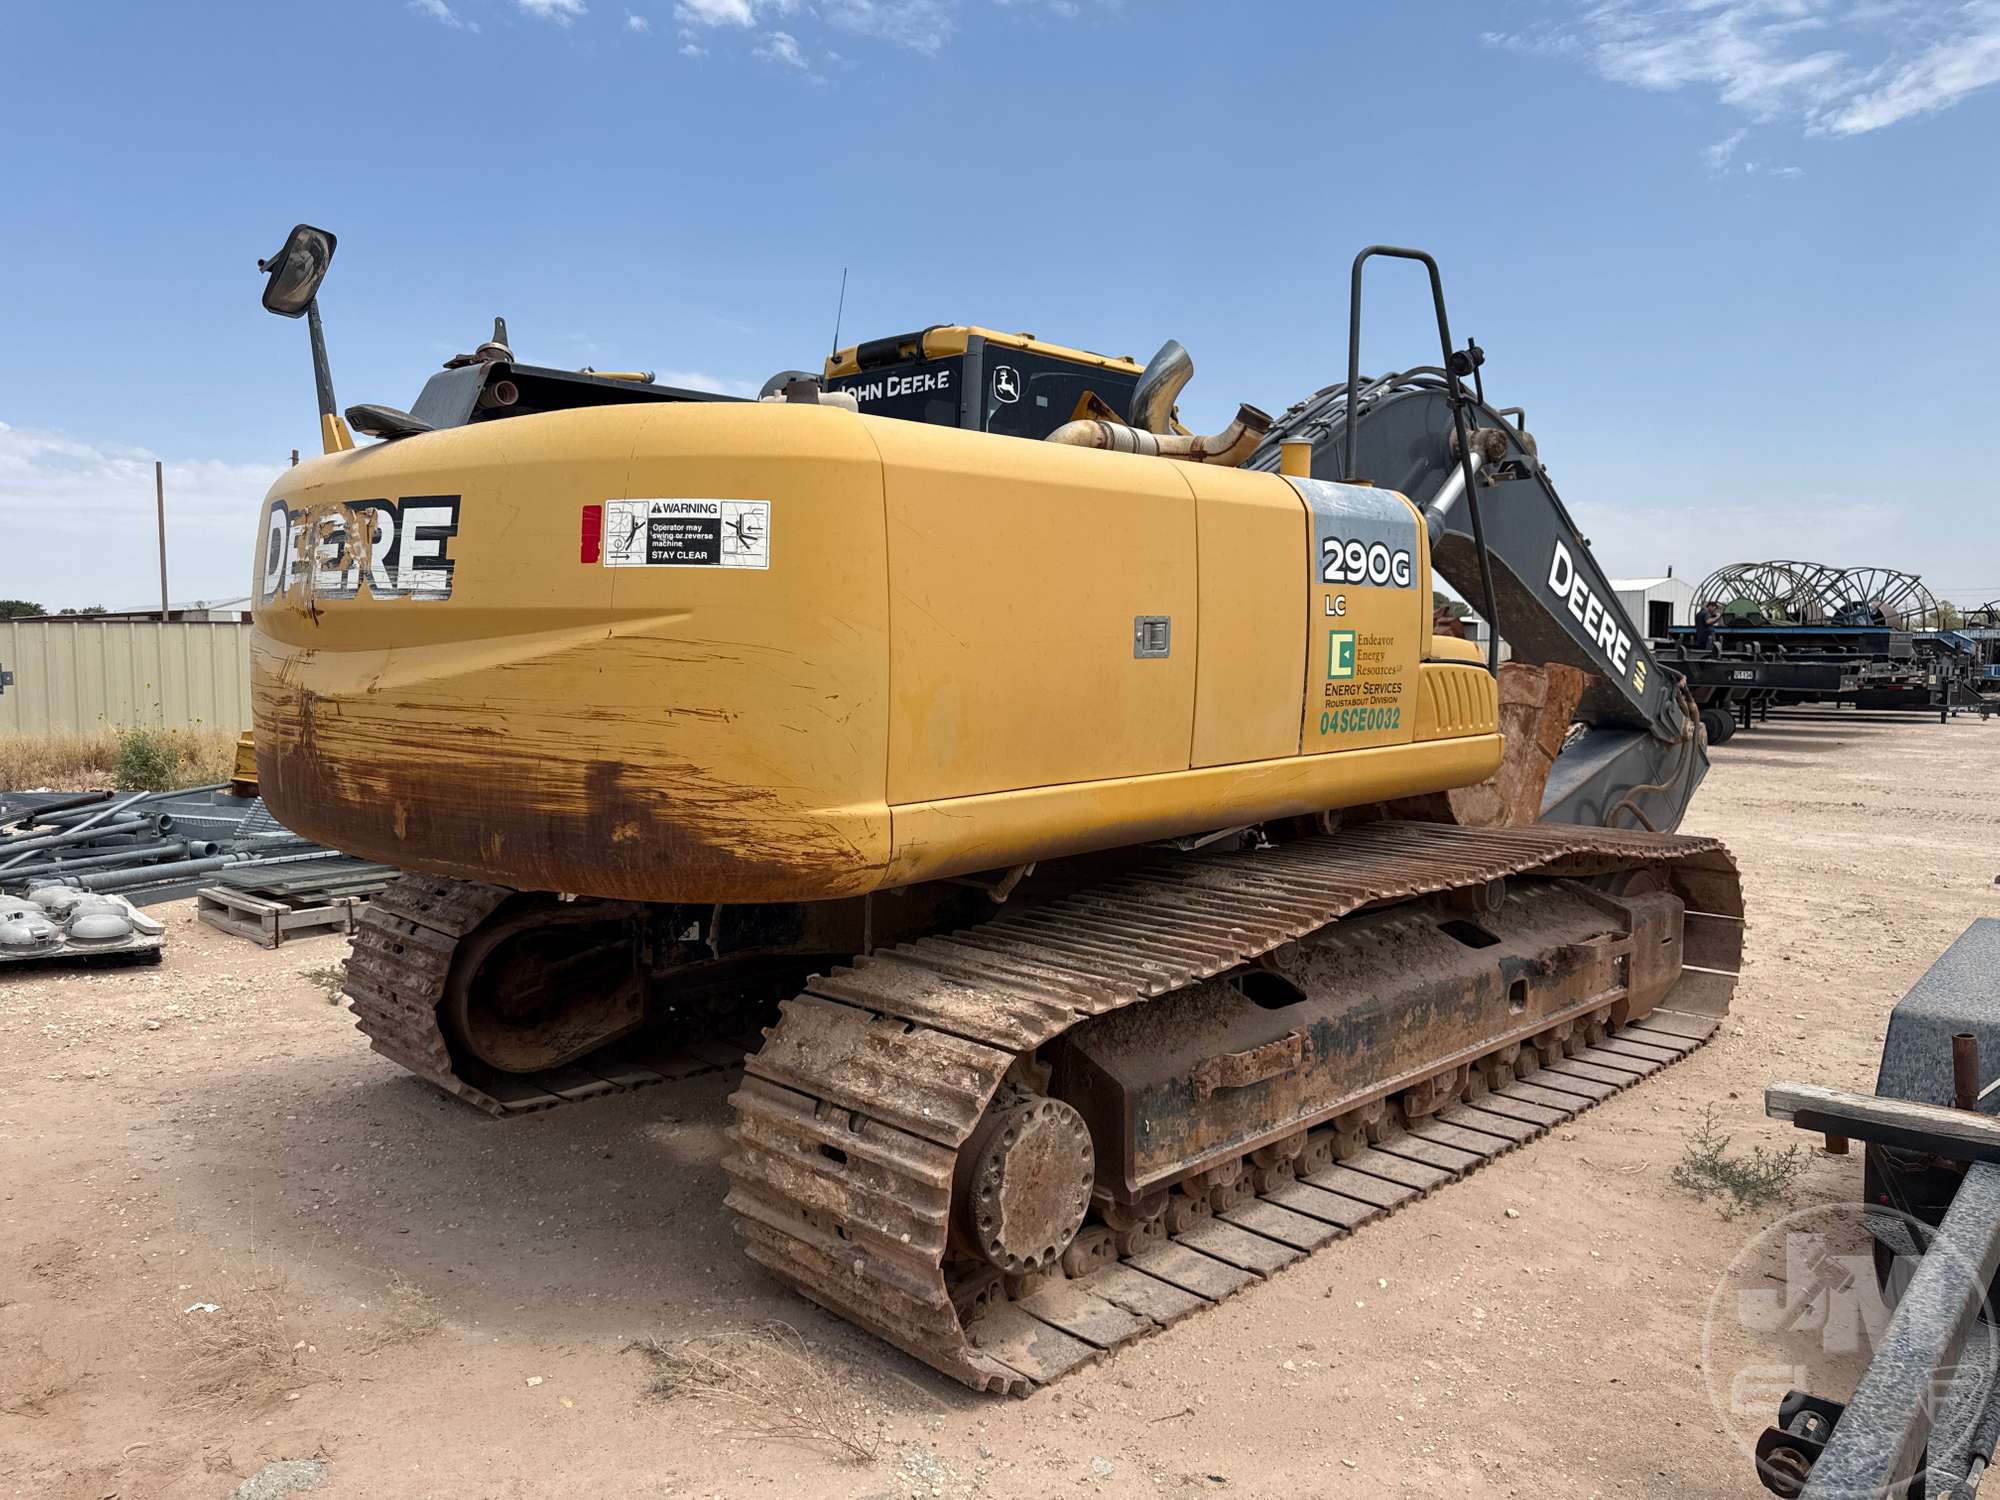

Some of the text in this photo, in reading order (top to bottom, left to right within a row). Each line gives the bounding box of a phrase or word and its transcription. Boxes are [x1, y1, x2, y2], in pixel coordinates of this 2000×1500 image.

[887, 371, 949, 397] DEERE
[663, 503, 717, 514] WARNING
[652, 523, 702, 533] Operator may
[652, 532, 674, 541] swing
[262, 496, 461, 600] DEERE
[652, 540, 683, 548] machine
[652, 550, 708, 560] STAY CLEAR
[1322, 536, 1410, 588] 290G
[1325, 594, 1346, 616] LC
[1547, 538, 1632, 677] DEERE
[1357, 633, 1395, 646] Endeavor
[1357, 649, 1386, 663] Energy
[1356, 664, 1396, 676] Resources
[1325, 682, 1402, 697] ENERGY SERVICES
[1325, 696, 1398, 709] ROUSTABOUT DIVISION
[1320, 706, 1401, 736] 04SCE0032
